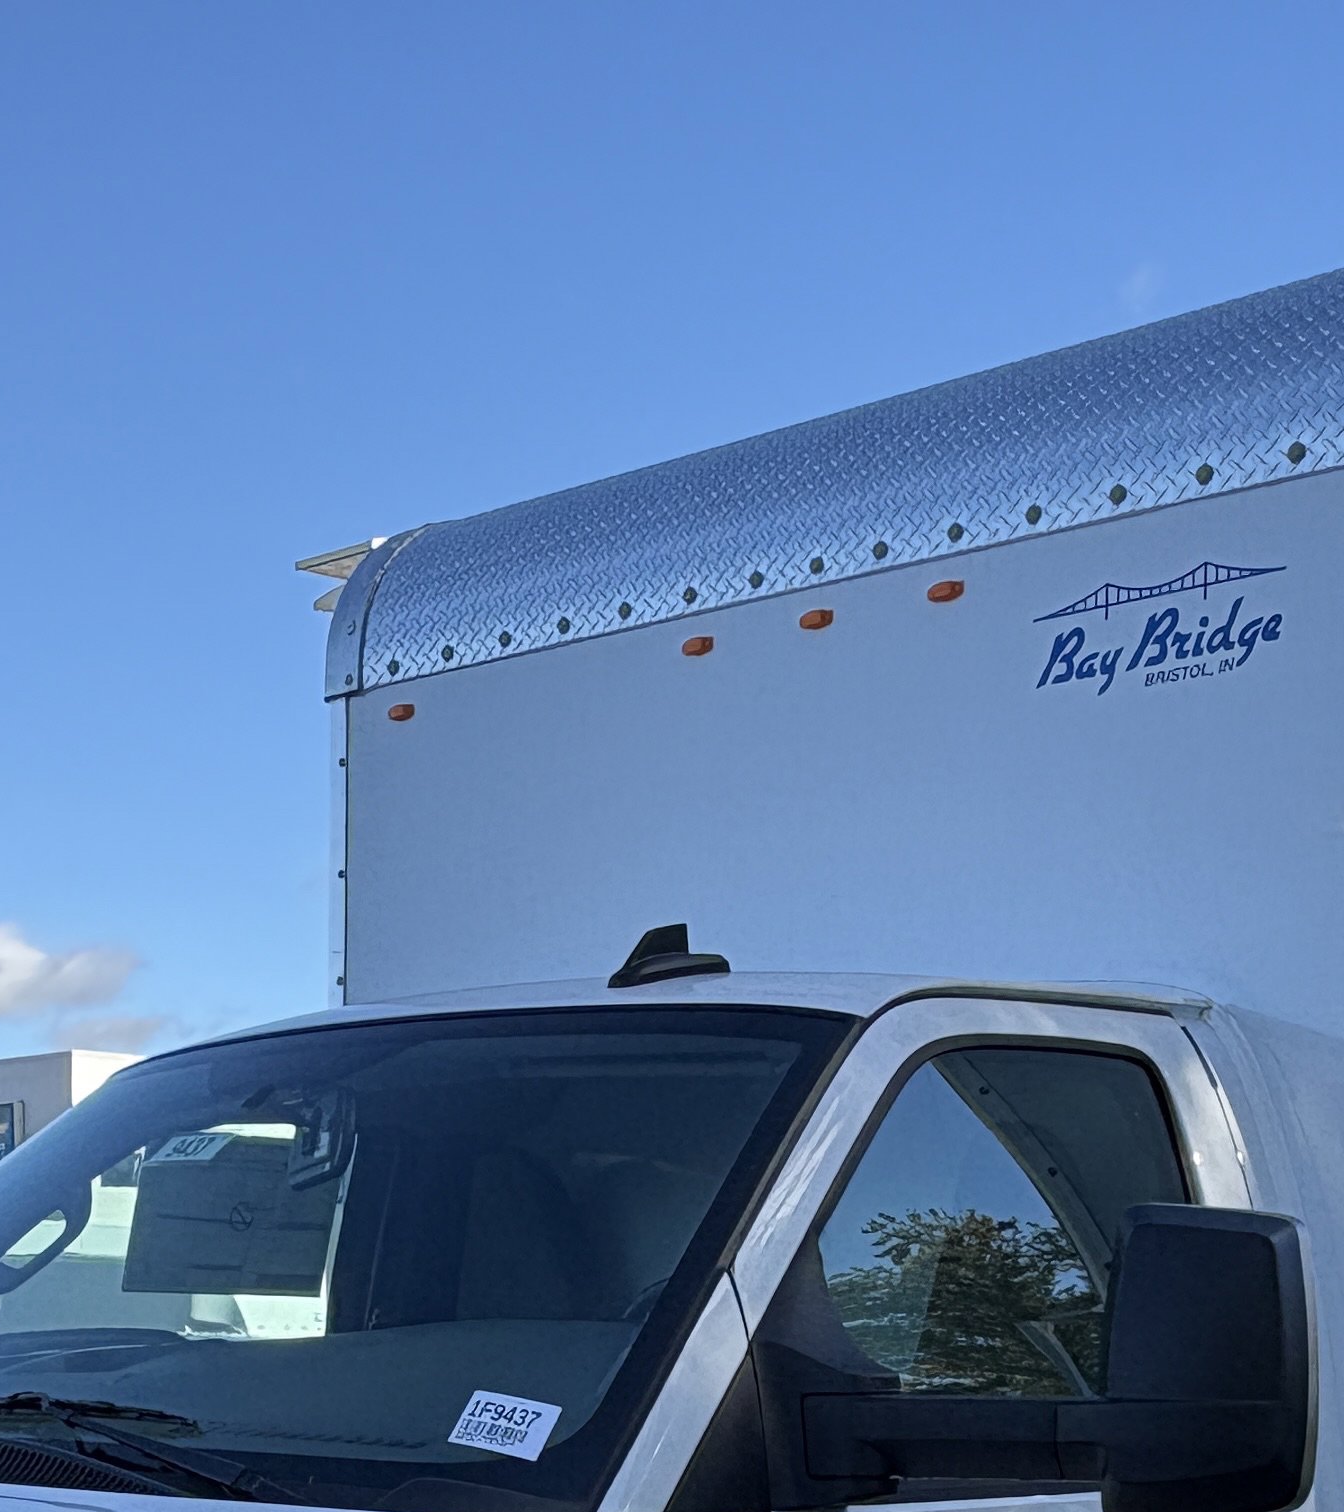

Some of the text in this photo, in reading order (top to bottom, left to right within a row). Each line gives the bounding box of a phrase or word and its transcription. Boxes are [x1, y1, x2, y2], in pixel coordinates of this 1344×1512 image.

[1035, 595, 1283, 696] Bay Bridge
[1218, 657, 1236, 675] IN
[468, 1400, 543, 1429] 1F9437
